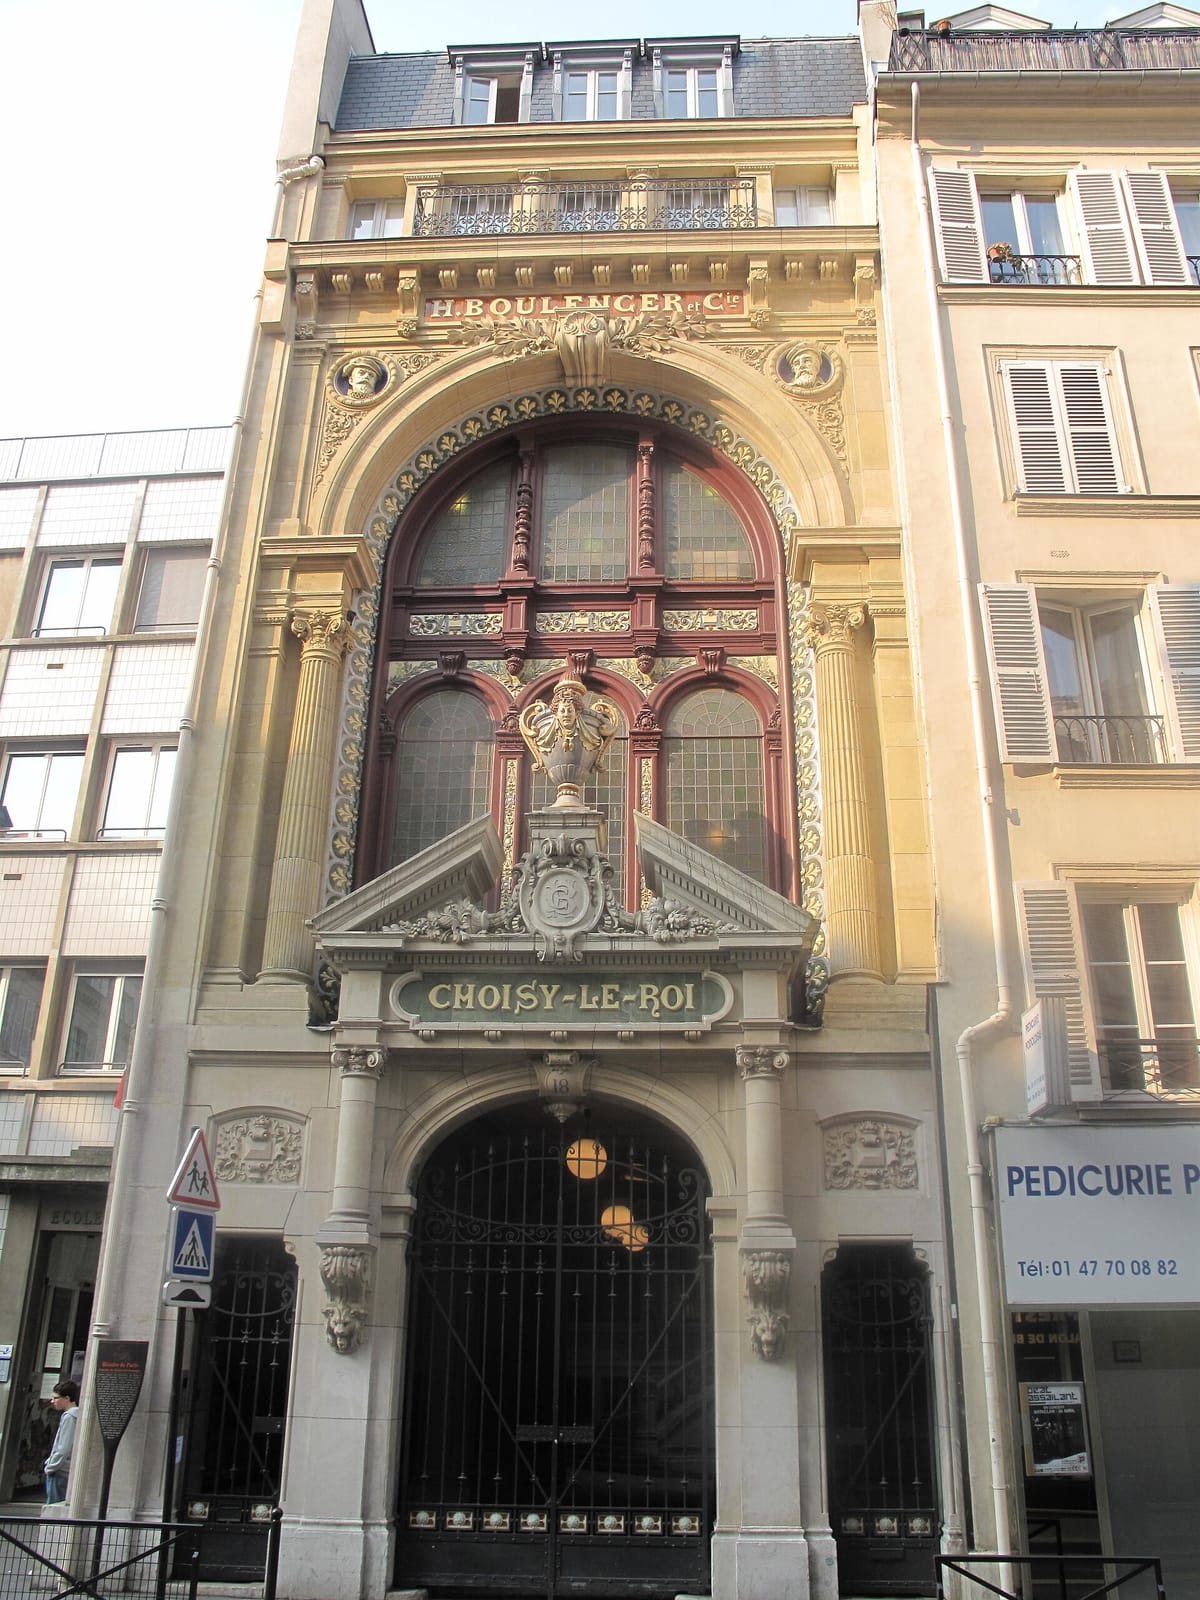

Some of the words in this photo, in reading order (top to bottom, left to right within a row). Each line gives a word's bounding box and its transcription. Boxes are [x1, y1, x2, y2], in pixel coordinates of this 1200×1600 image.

[687, 301, 701, 312] et
[428, 980, 695, 1018] CHOISY-LE-ROI
[552, 1078, 569, 1094] 18
[1007, 1164, 1172, 1197] PEDICURIE
[1079, 1260, 1098, 1276] 47
[1105, 1260, 1125, 1276] 70
[1131, 1259, 1151, 1276] 08
[1157, 1259, 1178, 1276] 82
